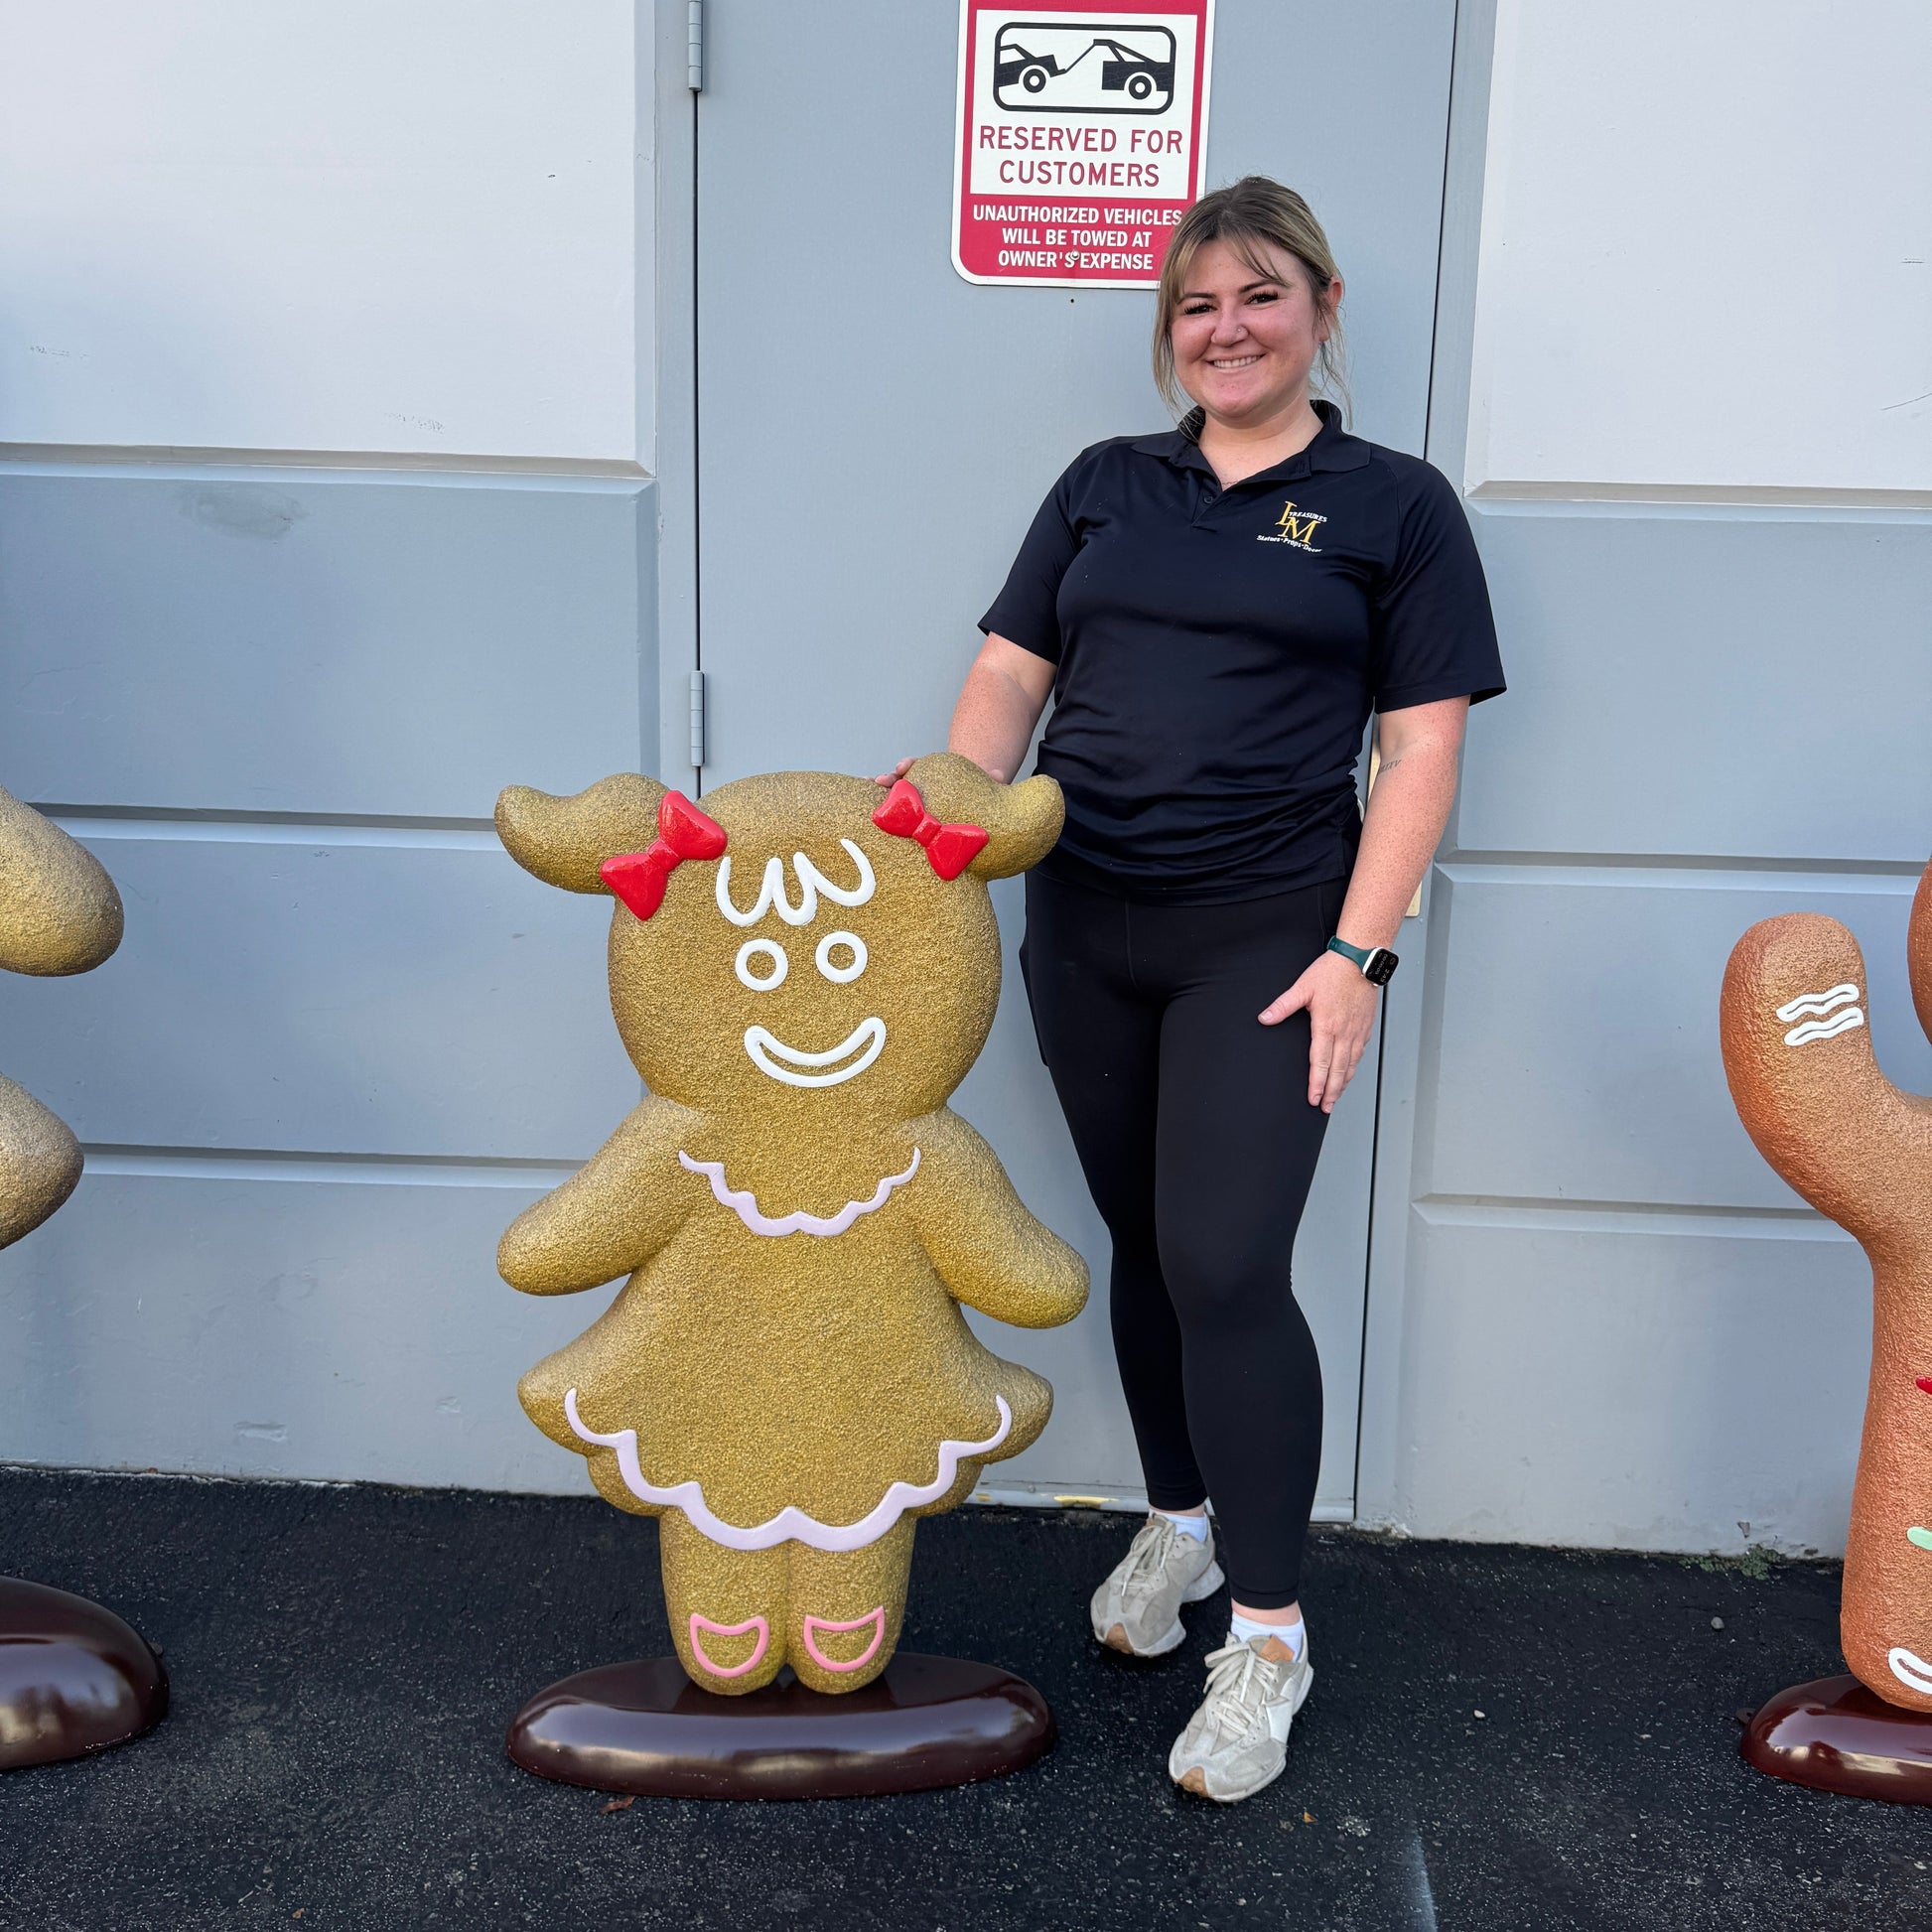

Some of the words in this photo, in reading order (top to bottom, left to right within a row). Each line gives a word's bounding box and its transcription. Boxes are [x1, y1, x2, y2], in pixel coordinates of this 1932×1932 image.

[980, 125, 1117, 152] RESERVED
[1130, 129, 1183, 154] FOR
[999, 160, 1160, 187] CUSTOMERS
[973, 205, 1099, 224] UNAUTHORIZED
[1103, 207, 1182, 226] VEHICLES
[1002, 227, 1040, 244] WILL
[1045, 229, 1067, 246] BE
[1070, 230, 1128, 246] TOWED
[1131, 231, 1153, 247] AT
[998, 250, 1075, 268] OWNER'S
[1079, 252, 1154, 270] EXPENSE
[1289, 511, 1328, 523] TREASURES
